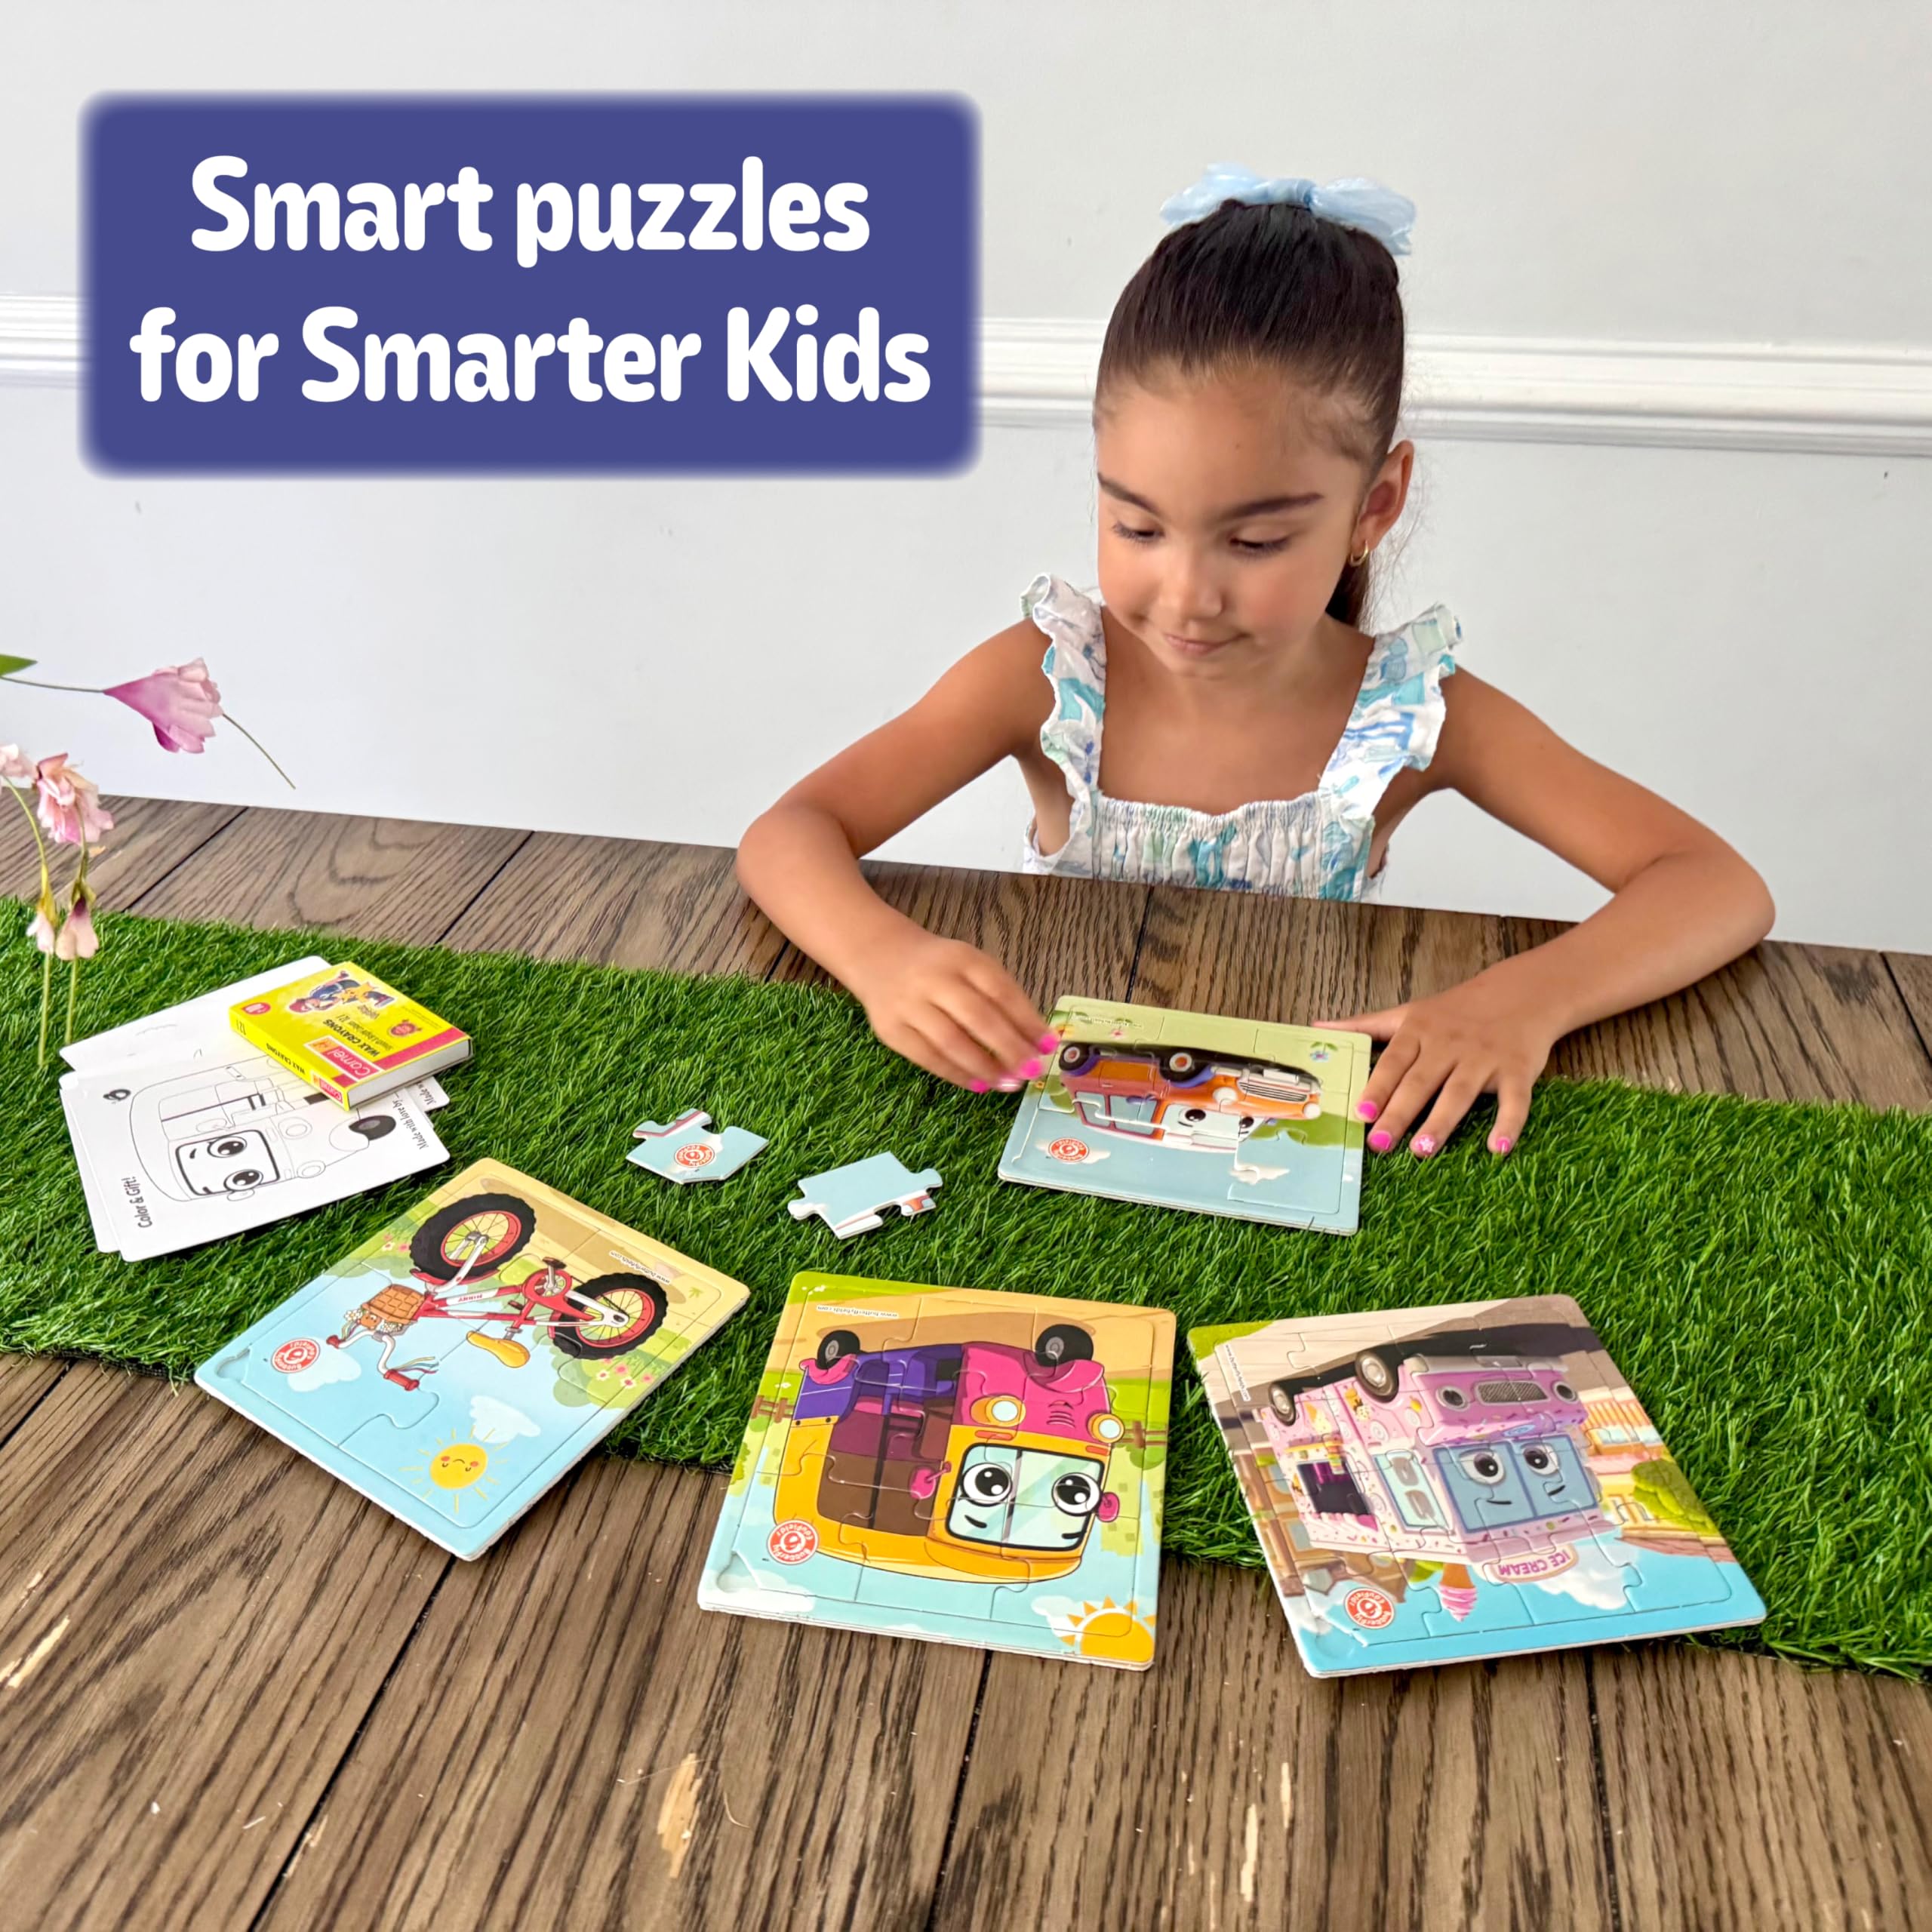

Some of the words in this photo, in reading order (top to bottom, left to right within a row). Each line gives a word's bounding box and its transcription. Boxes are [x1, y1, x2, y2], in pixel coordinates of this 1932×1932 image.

[323, 1019, 361, 1044] CRAYONS
[359, 1042, 380, 1057] WAX
[327, 1048, 371, 1076] Camel
[398, 1107, 411, 1121] love
[403, 1118, 417, 1132] with
[412, 1132, 429, 1149] Made
[121, 1176, 140, 1196] Gift!
[134, 1205, 152, 1228] Color
[1497, 1558, 1548, 1576] CREAM
[1548, 1549, 1571, 1567] ICE
